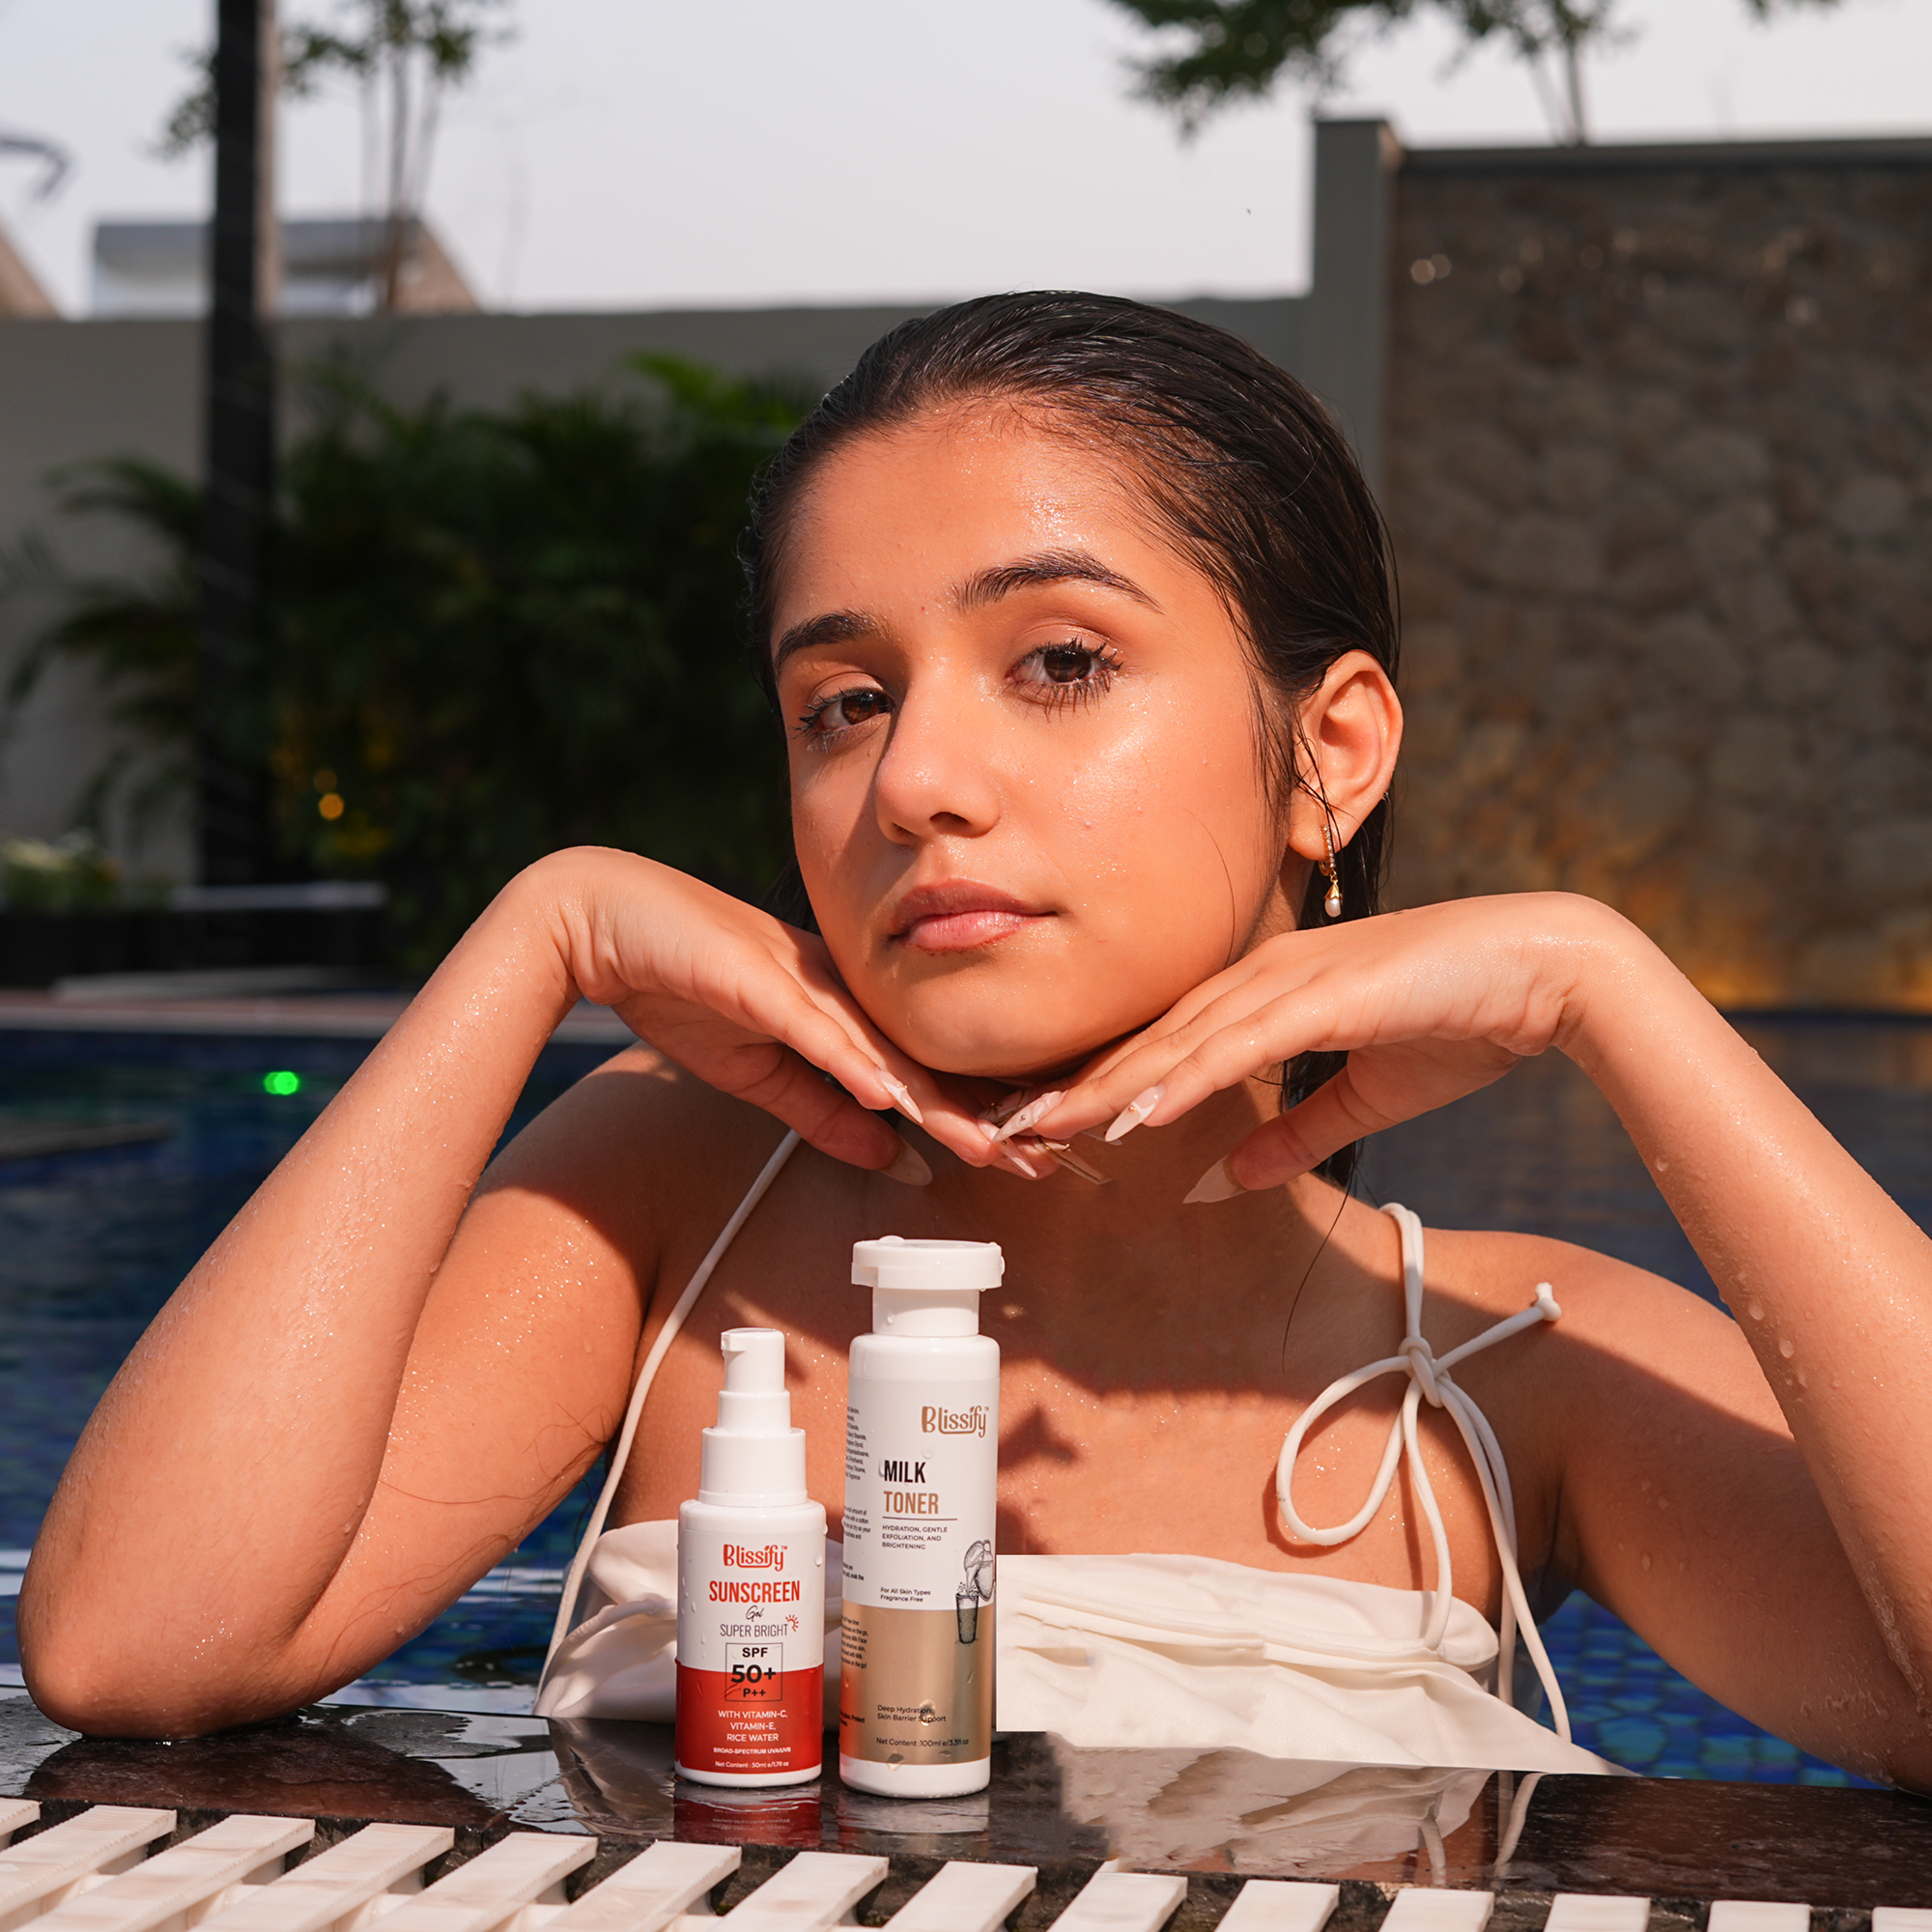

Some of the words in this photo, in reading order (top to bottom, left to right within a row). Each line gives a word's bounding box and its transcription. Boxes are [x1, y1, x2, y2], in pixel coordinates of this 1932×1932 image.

[884, 1460, 926, 1483] MILK
[883, 1491, 939, 1514] TONER
[882, 1525, 921, 1533] HYDRATION,
[882, 1533, 925, 1542] EXFOLIATION,
[881, 1541, 926, 1550] BRIGHTENING
[709, 1580, 800, 1603] SUNSCREEN
[745, 1605, 765, 1622] Gel
[720, 1624, 752, 1637] SUPER
[754, 1624, 788, 1637] BRIGHT
[742, 1647, 768, 1658] SPF
[731, 1664, 776, 1683] 50+
[743, 1688, 766, 1697] P++
[877, 1705, 895, 1713] Deep
[727, 1734, 747, 1742] RICE
[749, 1733, 779, 1742] WATER
